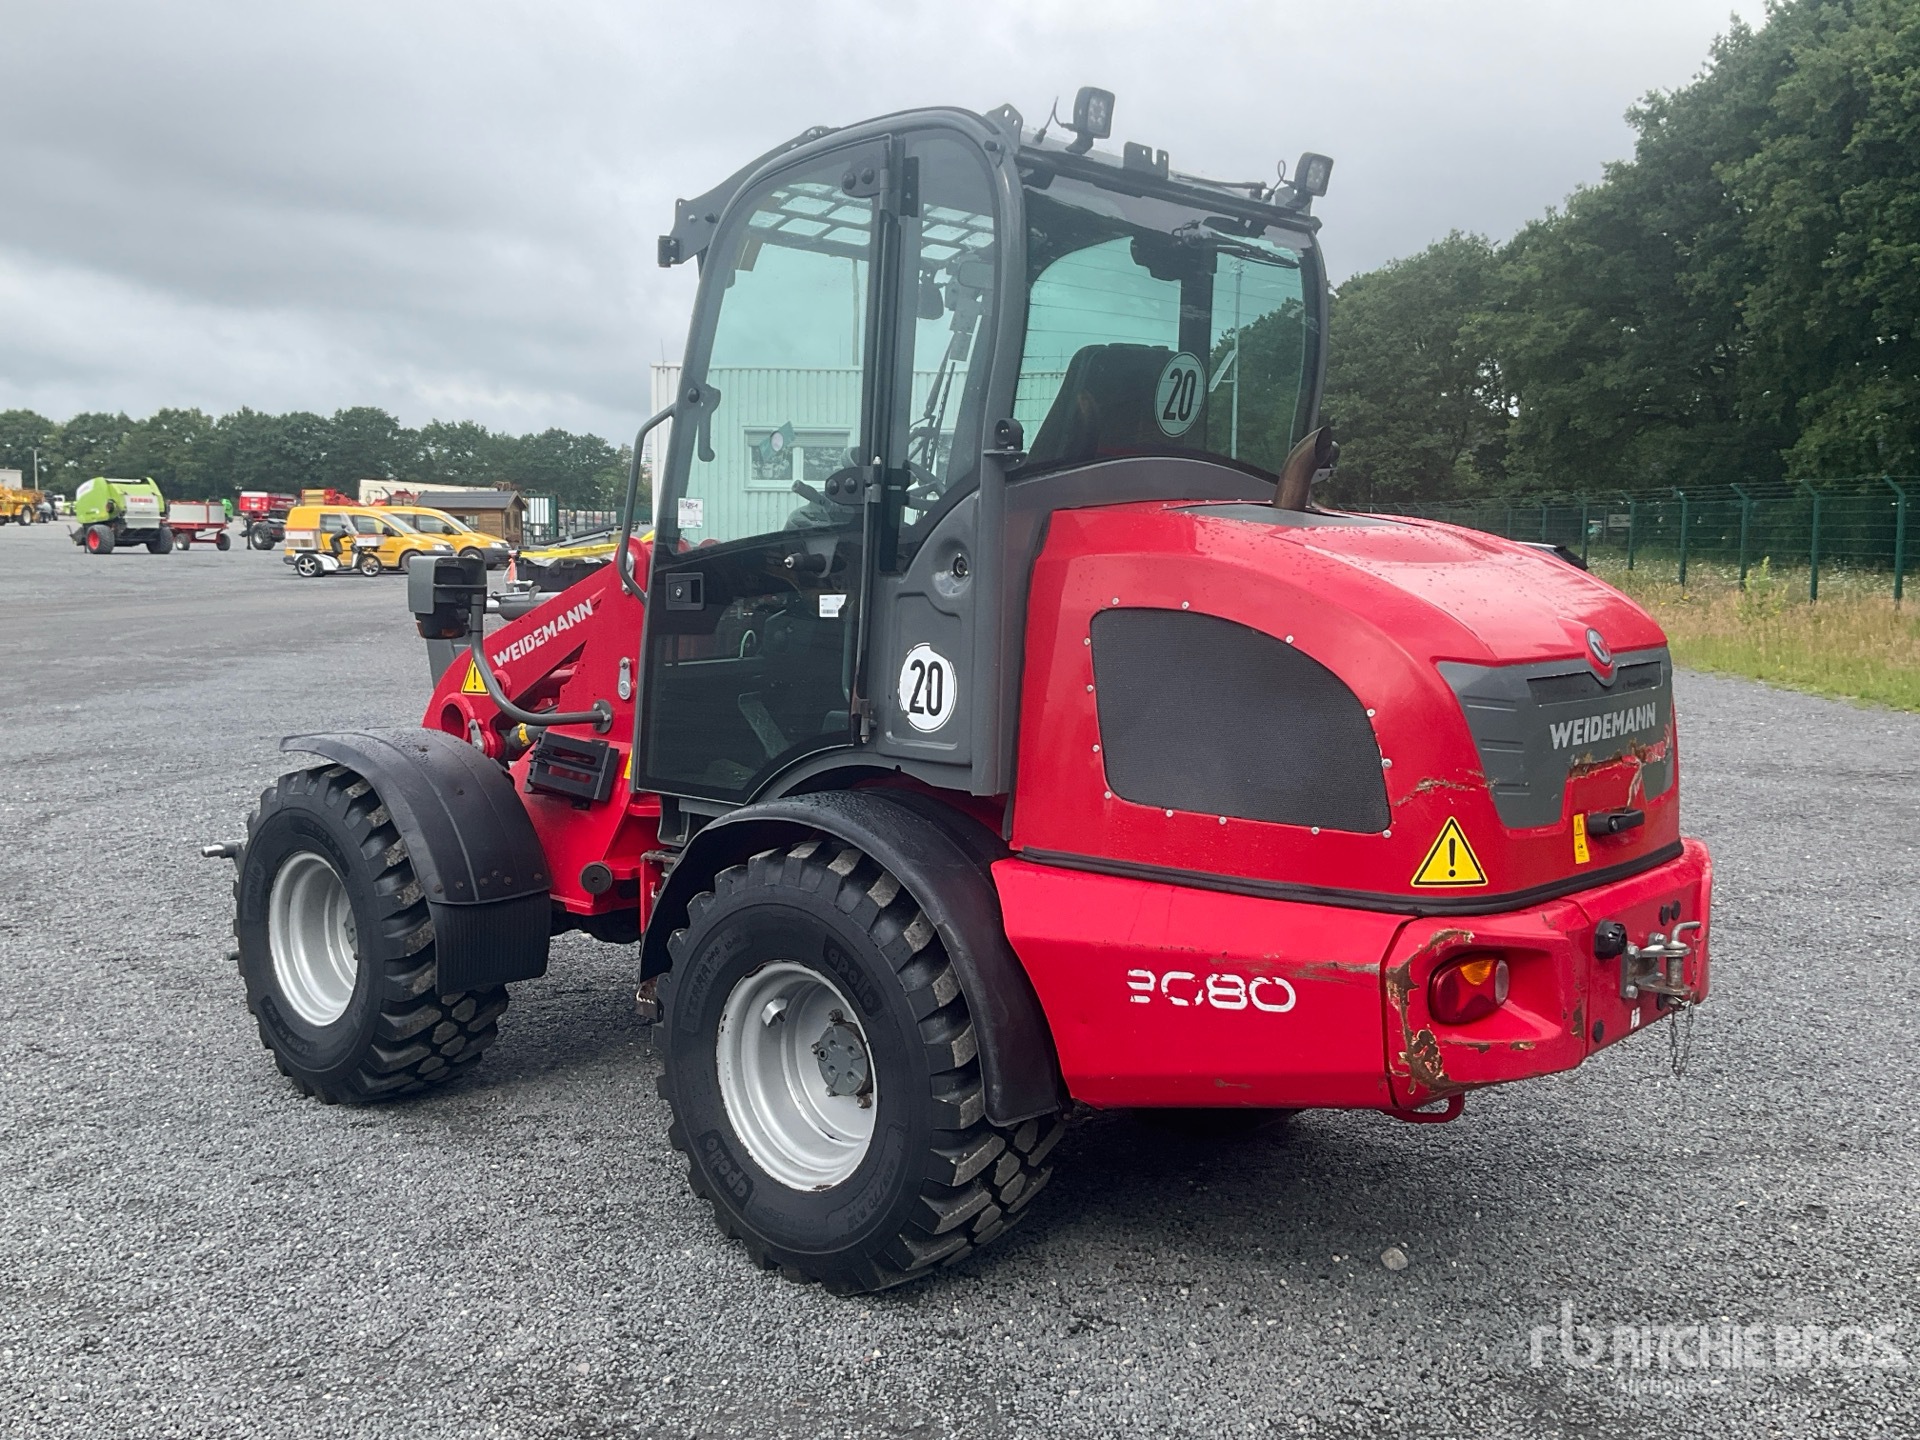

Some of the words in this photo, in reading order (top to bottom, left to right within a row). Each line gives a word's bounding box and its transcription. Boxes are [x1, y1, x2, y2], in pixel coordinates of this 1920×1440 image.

[1162, 367, 1197, 421] 20
[492, 598, 594, 668] WEIDEMANN
[909, 658, 943, 716] 20
[1549, 701, 1656, 750] WEIDEMANN
[827, 946, 875, 1010] apollo
[1127, 968, 1296, 1013] 3080
[703, 1136, 748, 1198] apollo
